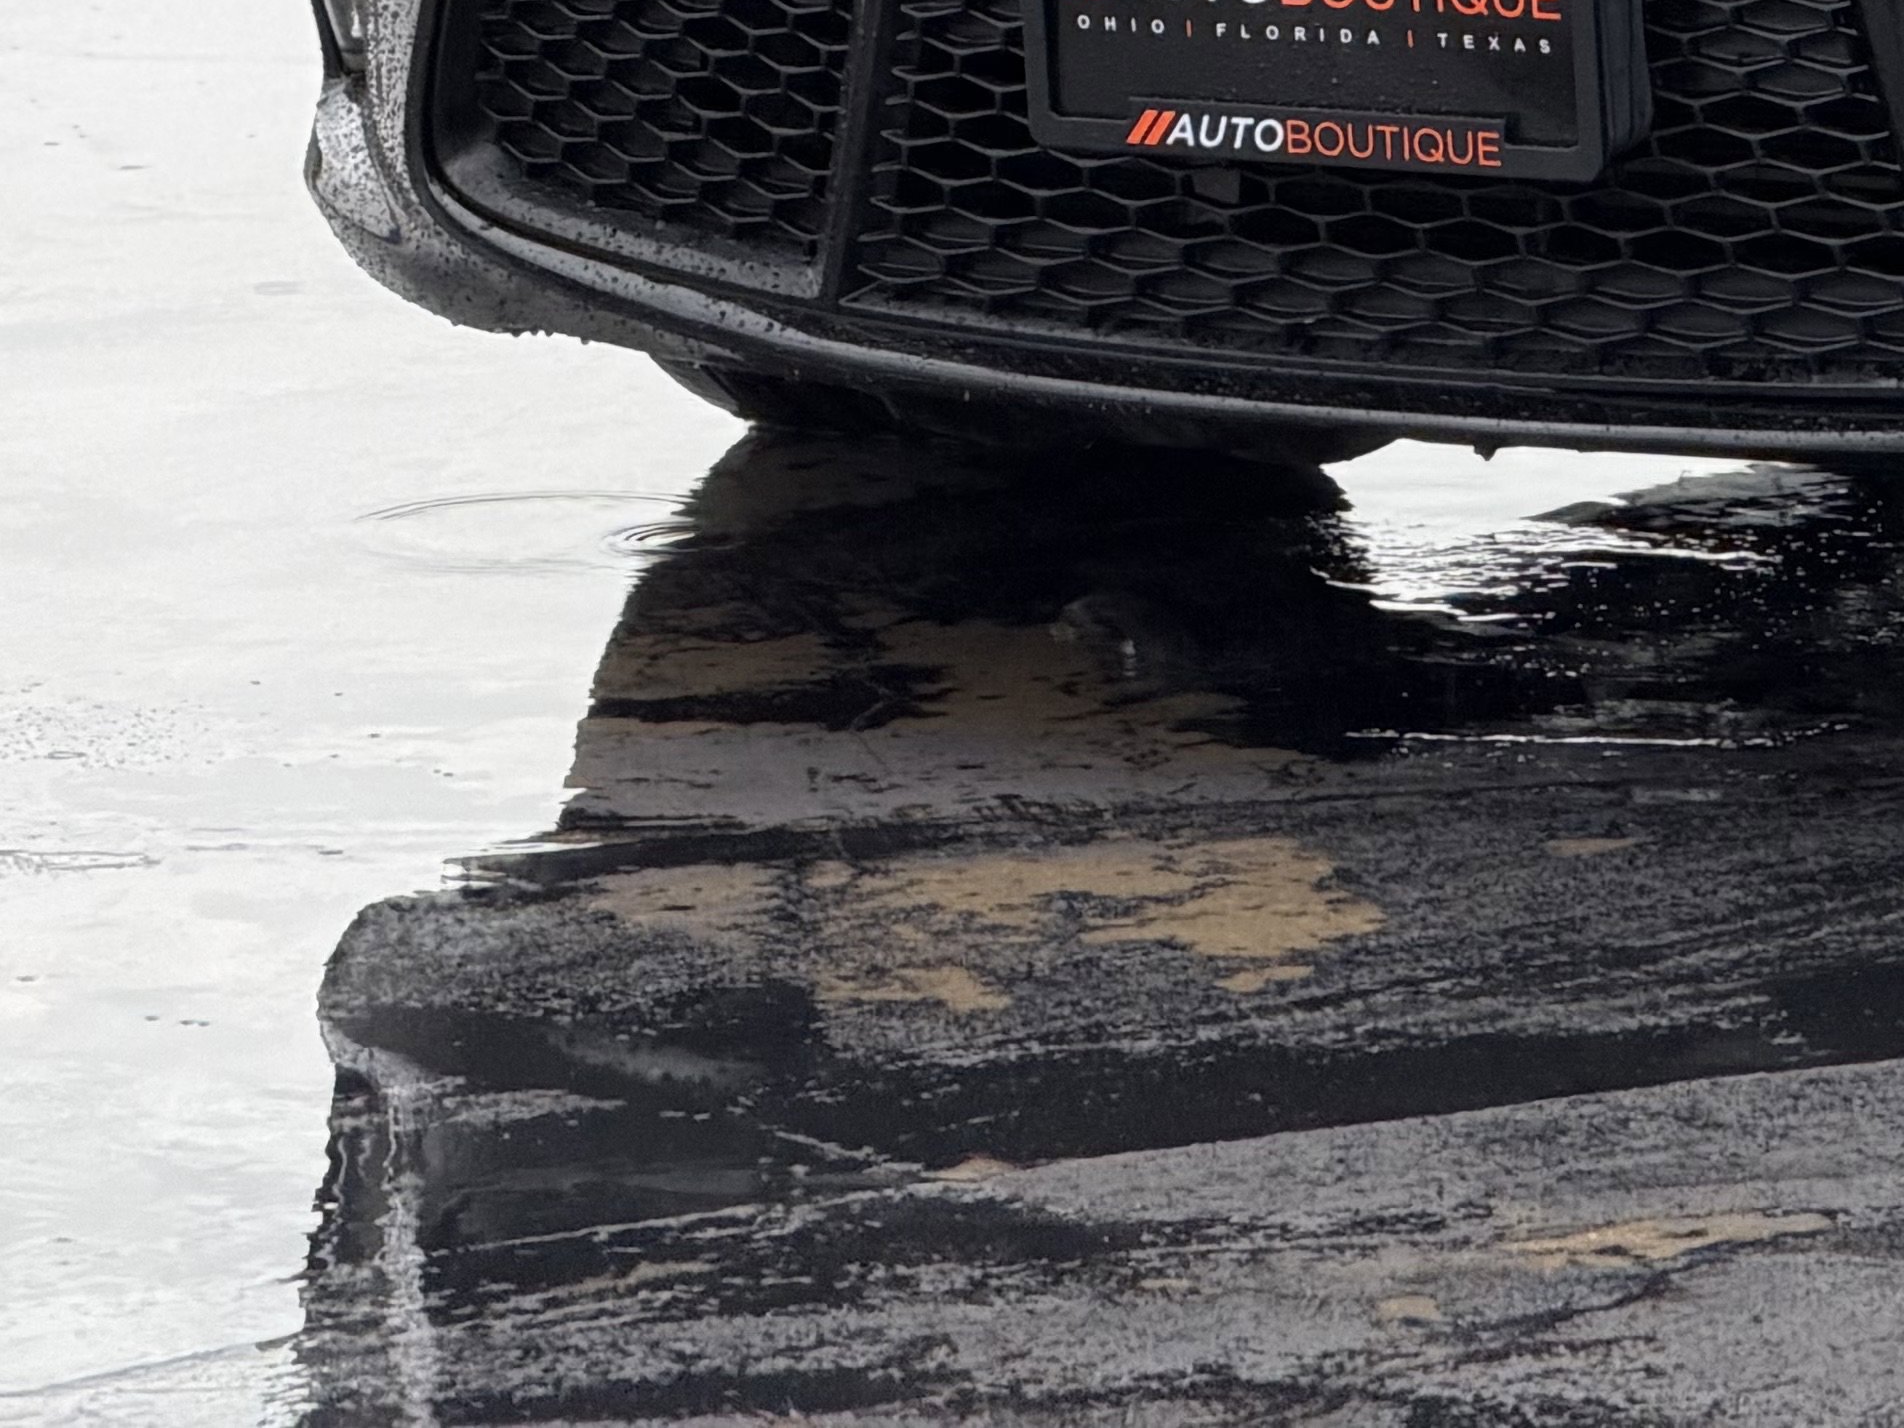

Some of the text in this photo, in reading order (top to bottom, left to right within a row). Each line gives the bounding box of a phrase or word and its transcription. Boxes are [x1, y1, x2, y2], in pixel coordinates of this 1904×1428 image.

[1077, 14, 1551, 54] OHIO FLORIDA TEXAS
